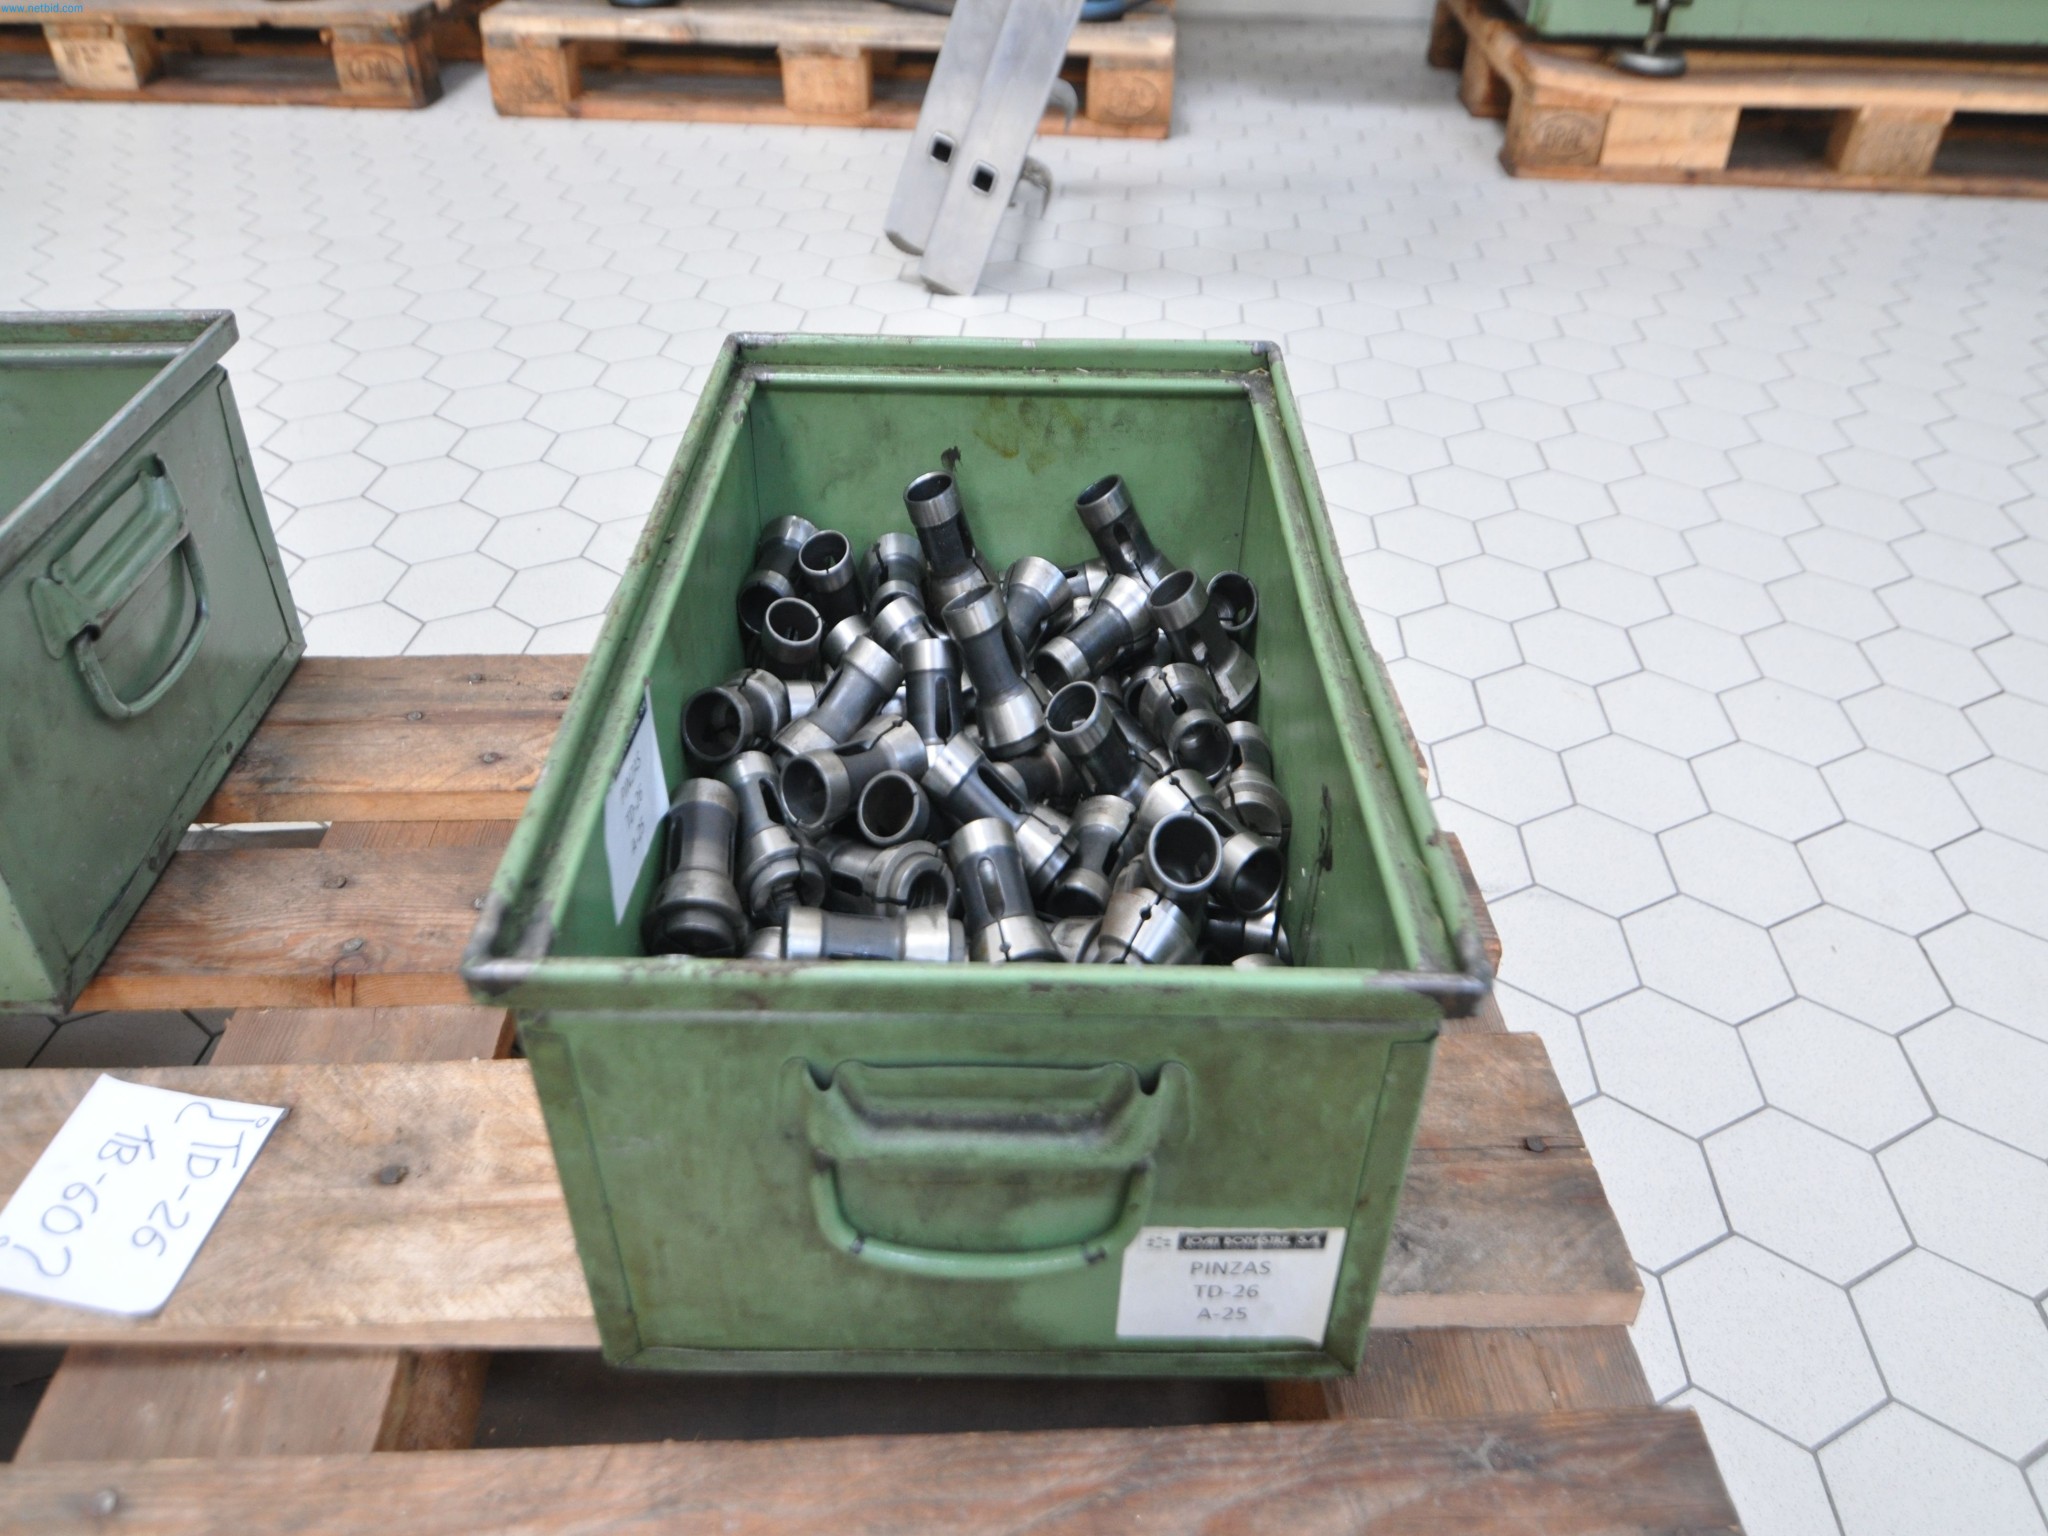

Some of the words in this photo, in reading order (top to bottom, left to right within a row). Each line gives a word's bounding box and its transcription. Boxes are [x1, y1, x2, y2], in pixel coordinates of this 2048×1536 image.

[1189, 1260, 1272, 1276] PINZAS
[1193, 1283, 1260, 1299] TD-26
[1196, 1306, 1248, 1321] A-25
